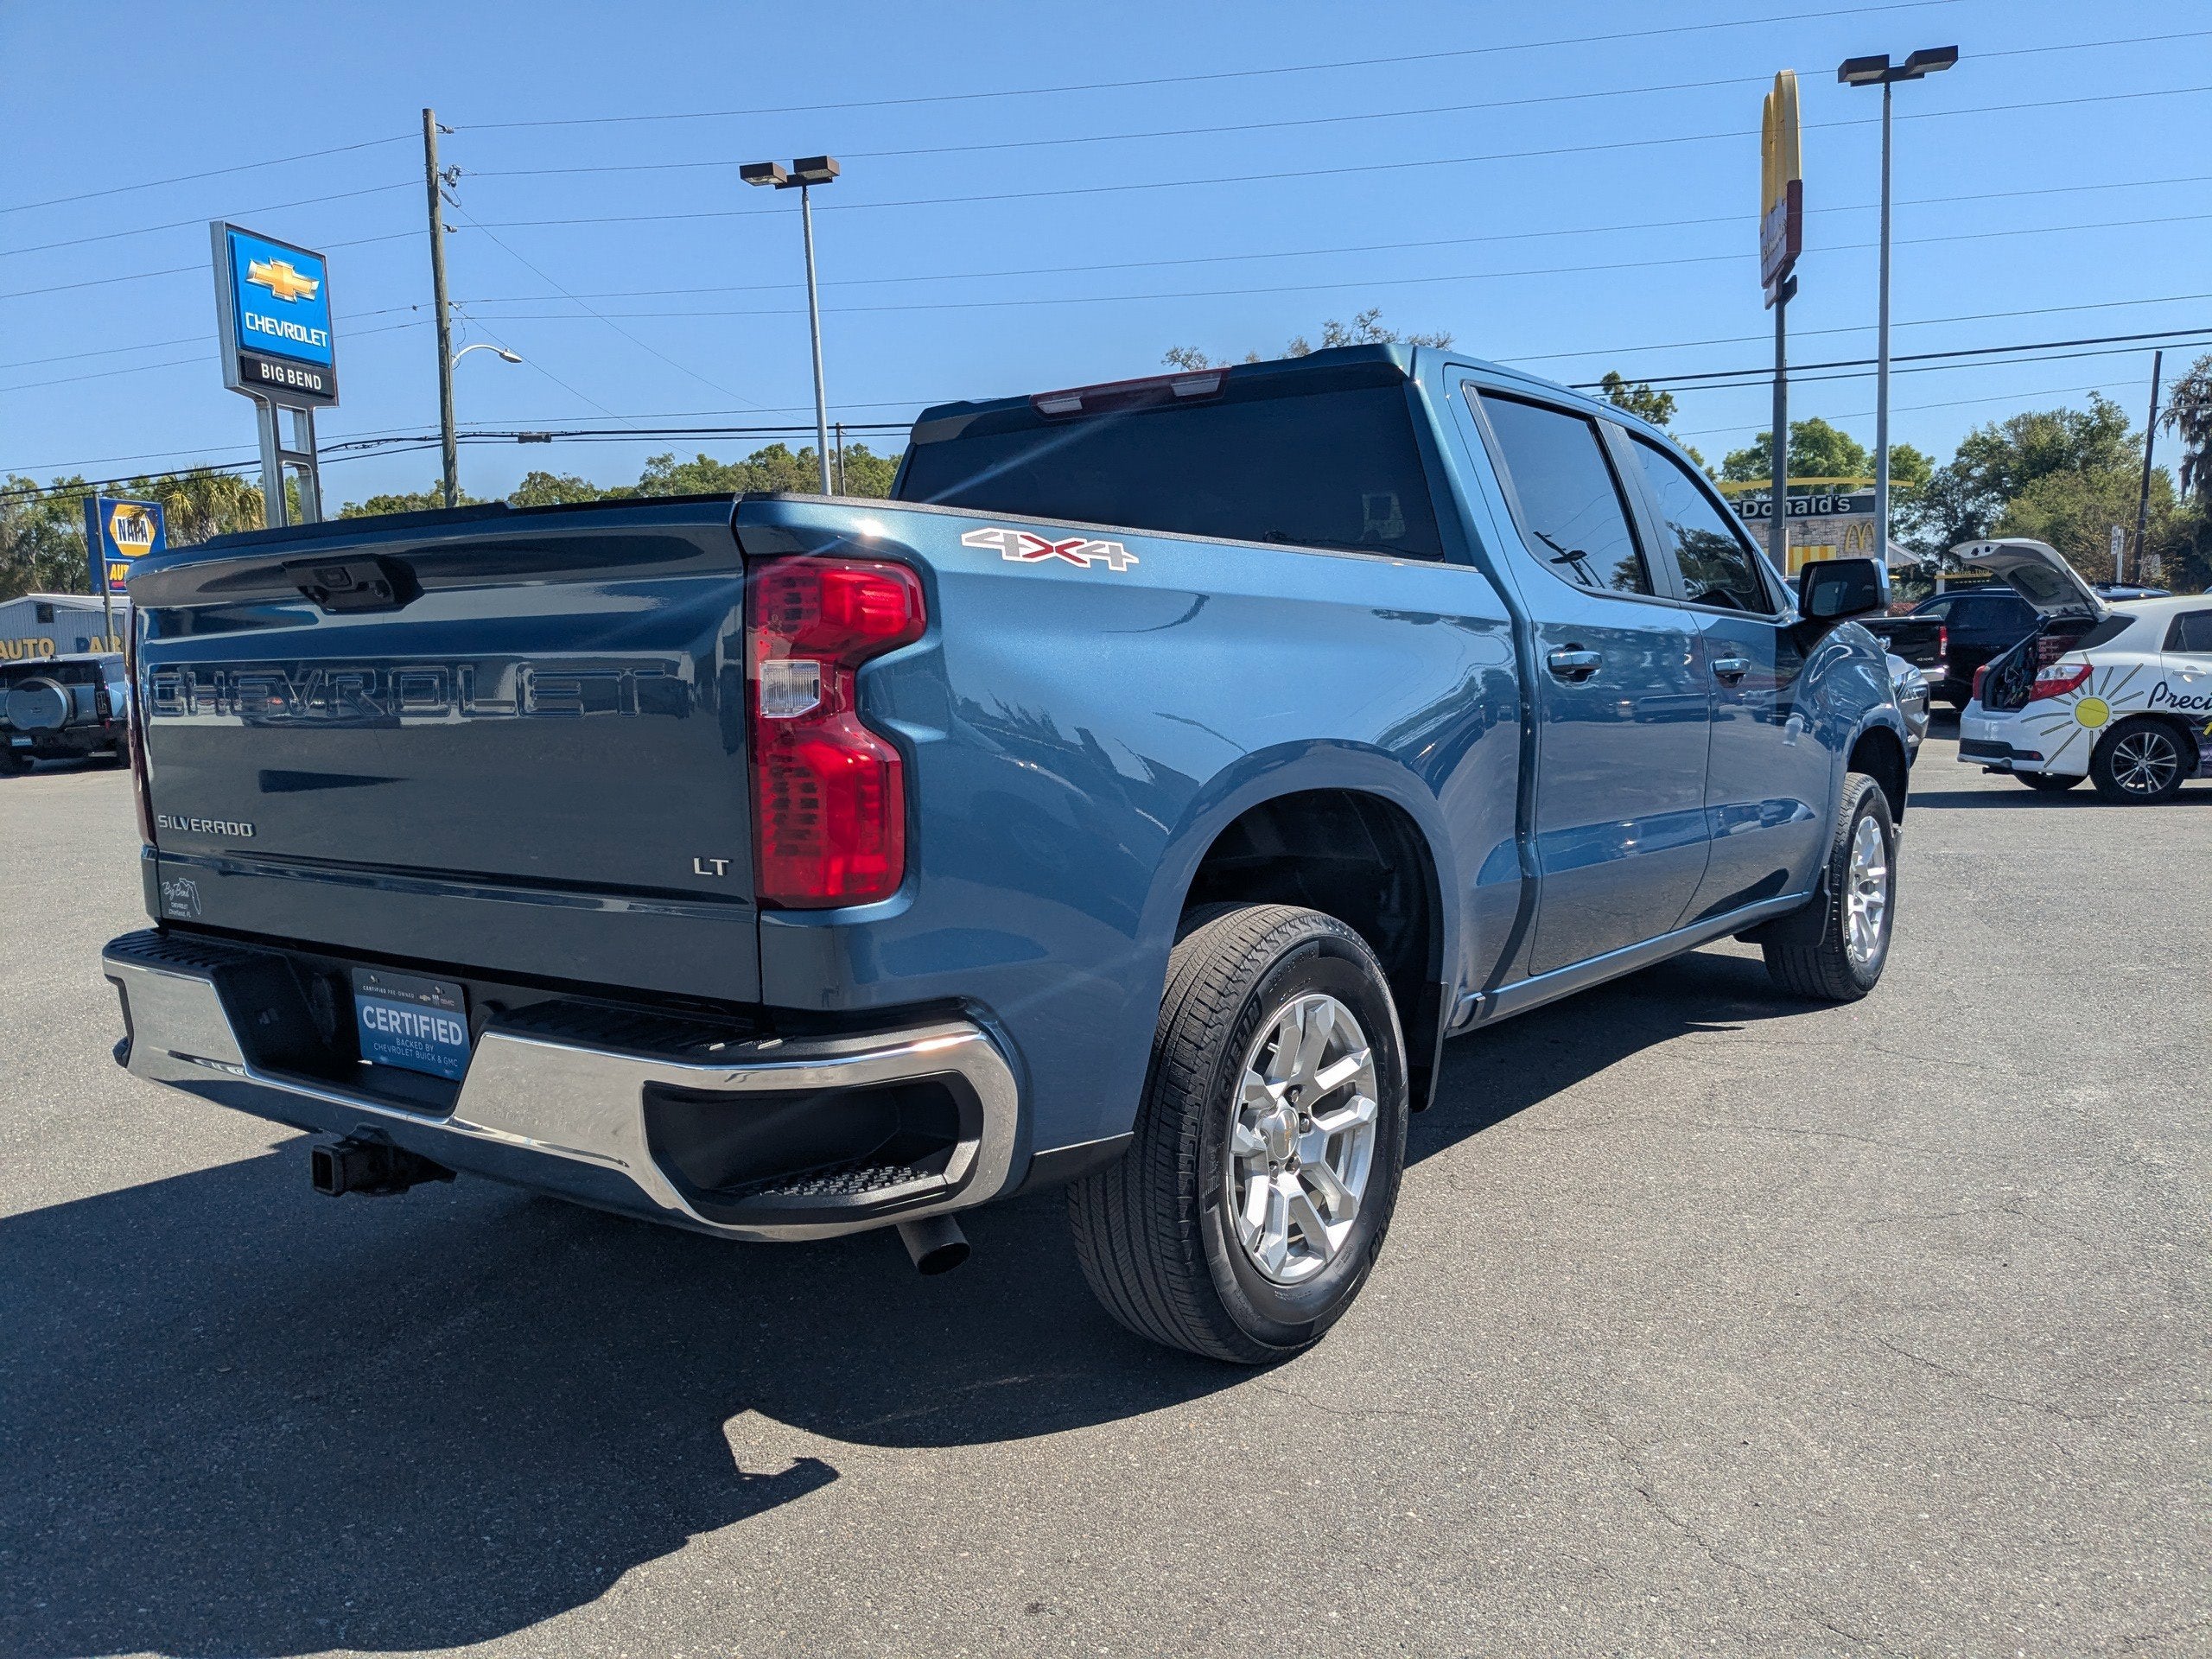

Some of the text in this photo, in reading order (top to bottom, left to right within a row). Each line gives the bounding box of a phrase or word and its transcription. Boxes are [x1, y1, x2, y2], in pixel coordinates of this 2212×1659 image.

[245, 312, 327, 347] CHEVROLET
[261, 363, 321, 390] BIG BEND
[1730, 495, 1851, 518] cDonald's
[151, 661, 666, 719] CHEVROLET
[157, 815, 254, 837] SILVERADO
[694, 857, 730, 876] LT
[363, 1005, 463, 1046] CERTIFIED
[373, 1042, 458, 1067] CHEVROLET BUICK & GMC
[396, 1038, 434, 1052] BACKED BY
